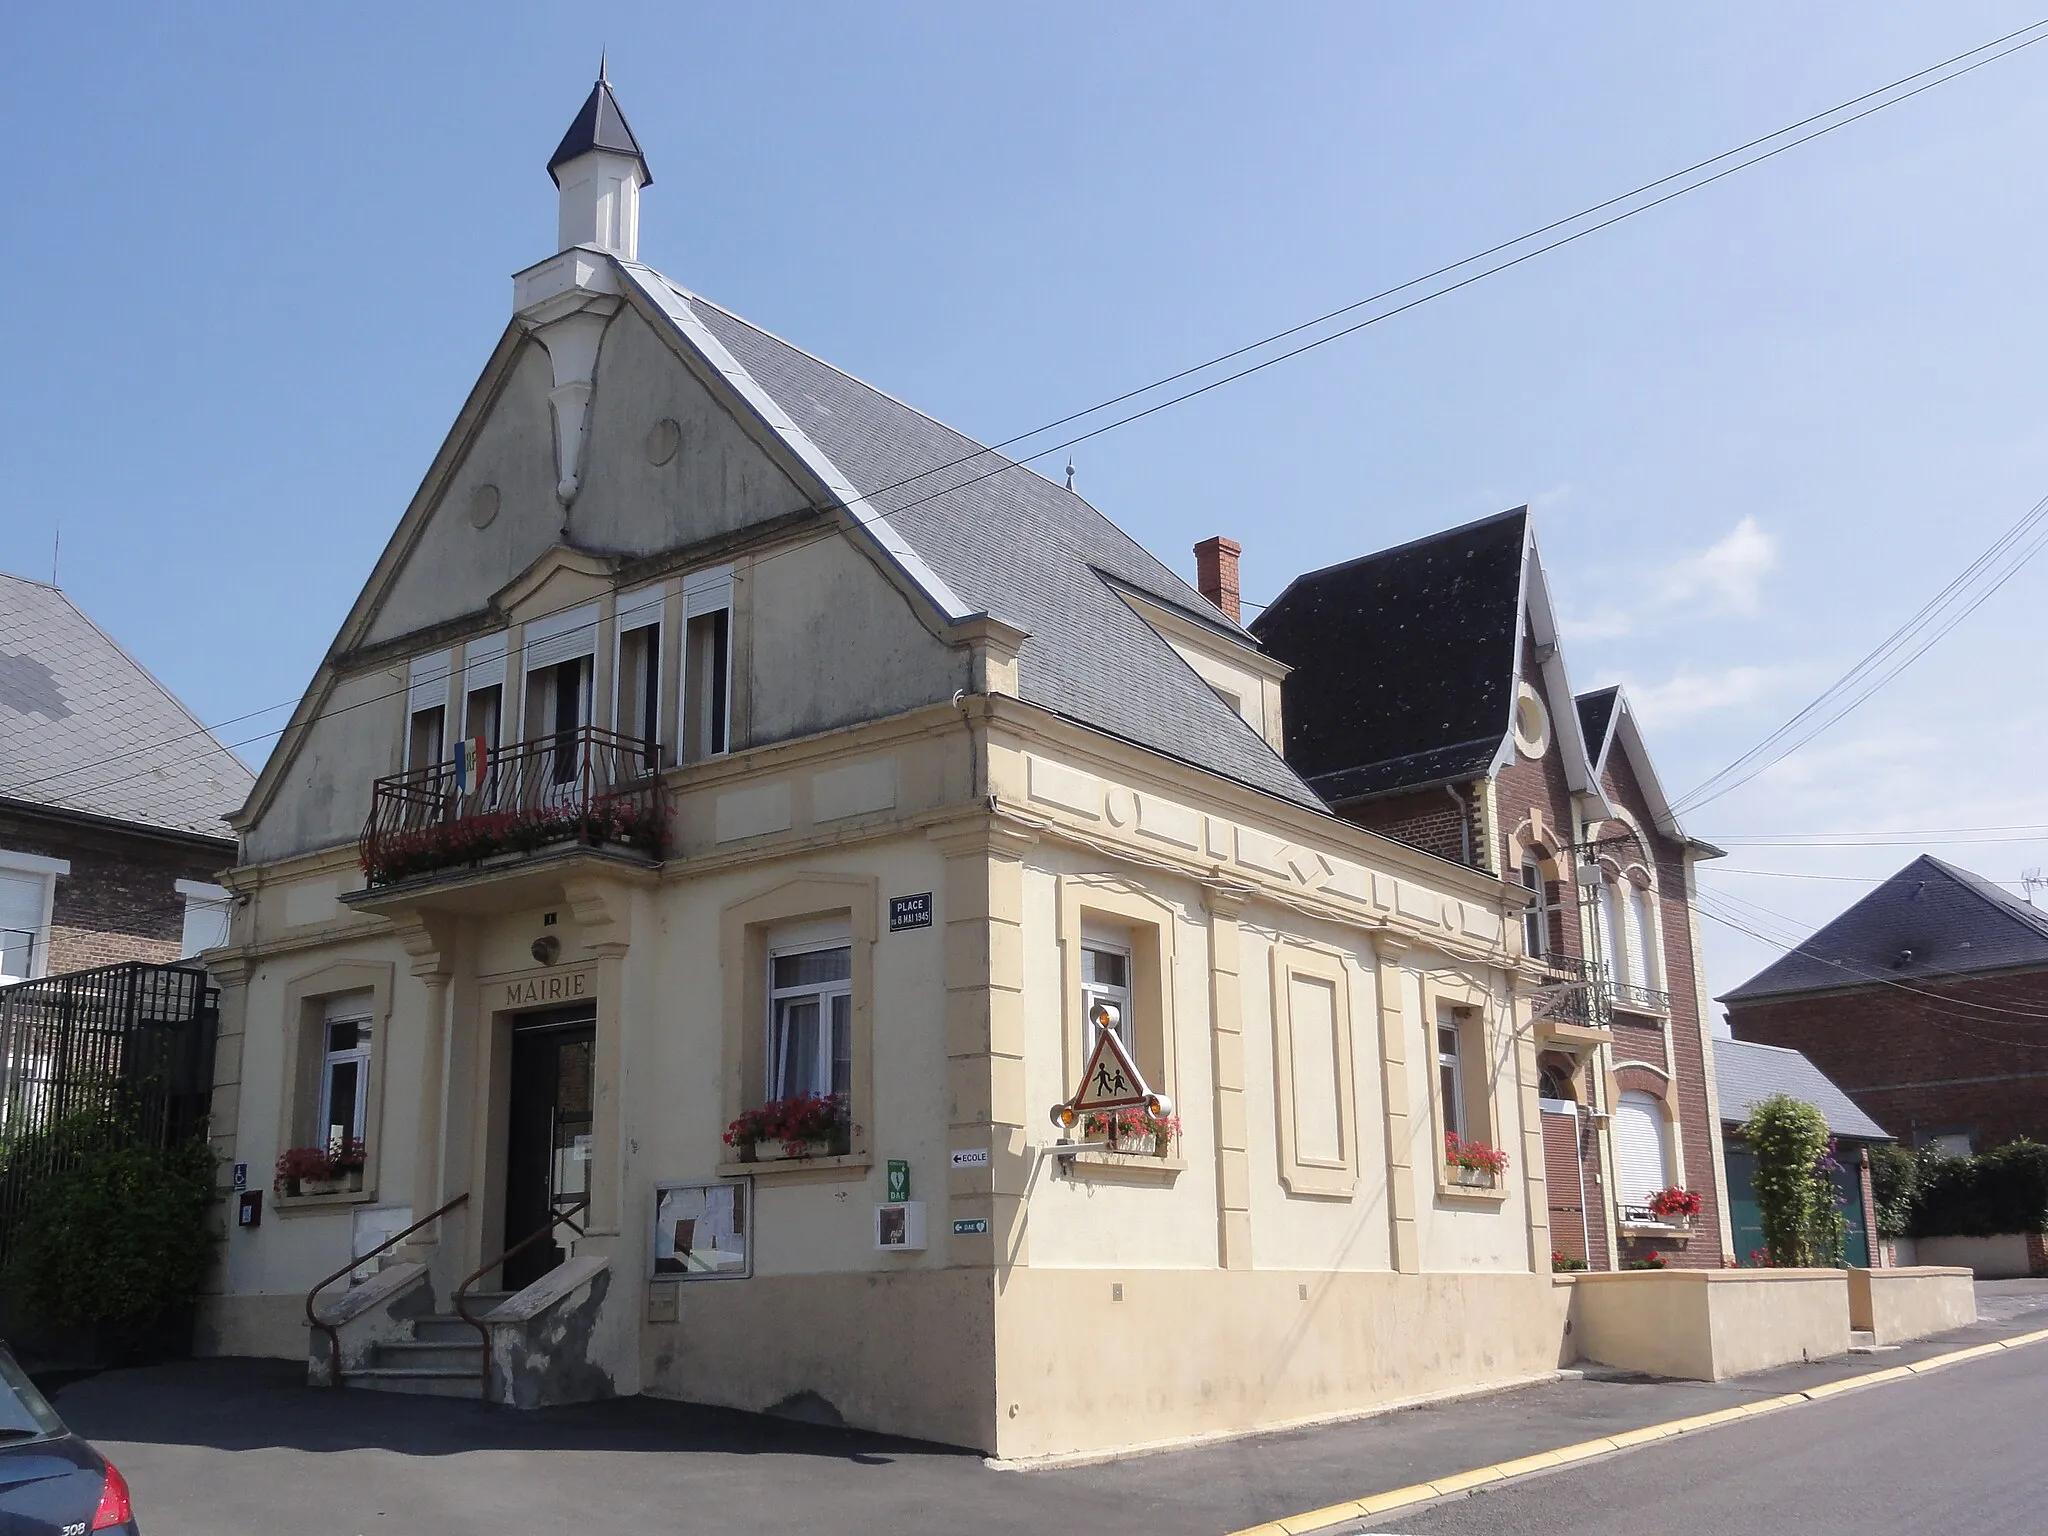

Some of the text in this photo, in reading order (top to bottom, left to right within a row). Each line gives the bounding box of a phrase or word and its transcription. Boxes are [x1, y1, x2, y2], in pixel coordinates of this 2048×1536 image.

[897, 900, 923, 912] PLACE
[897, 916, 902, 925] 8
[903, 914, 914, 923] MAI
[915, 911, 929, 921] 1945
[506, 974, 585, 1005] MAIRIE
[962, 1153, 987, 1162] ECOLE
[890, 1191, 906, 1200] DAE
[61, 1522, 86, 1536] 308
